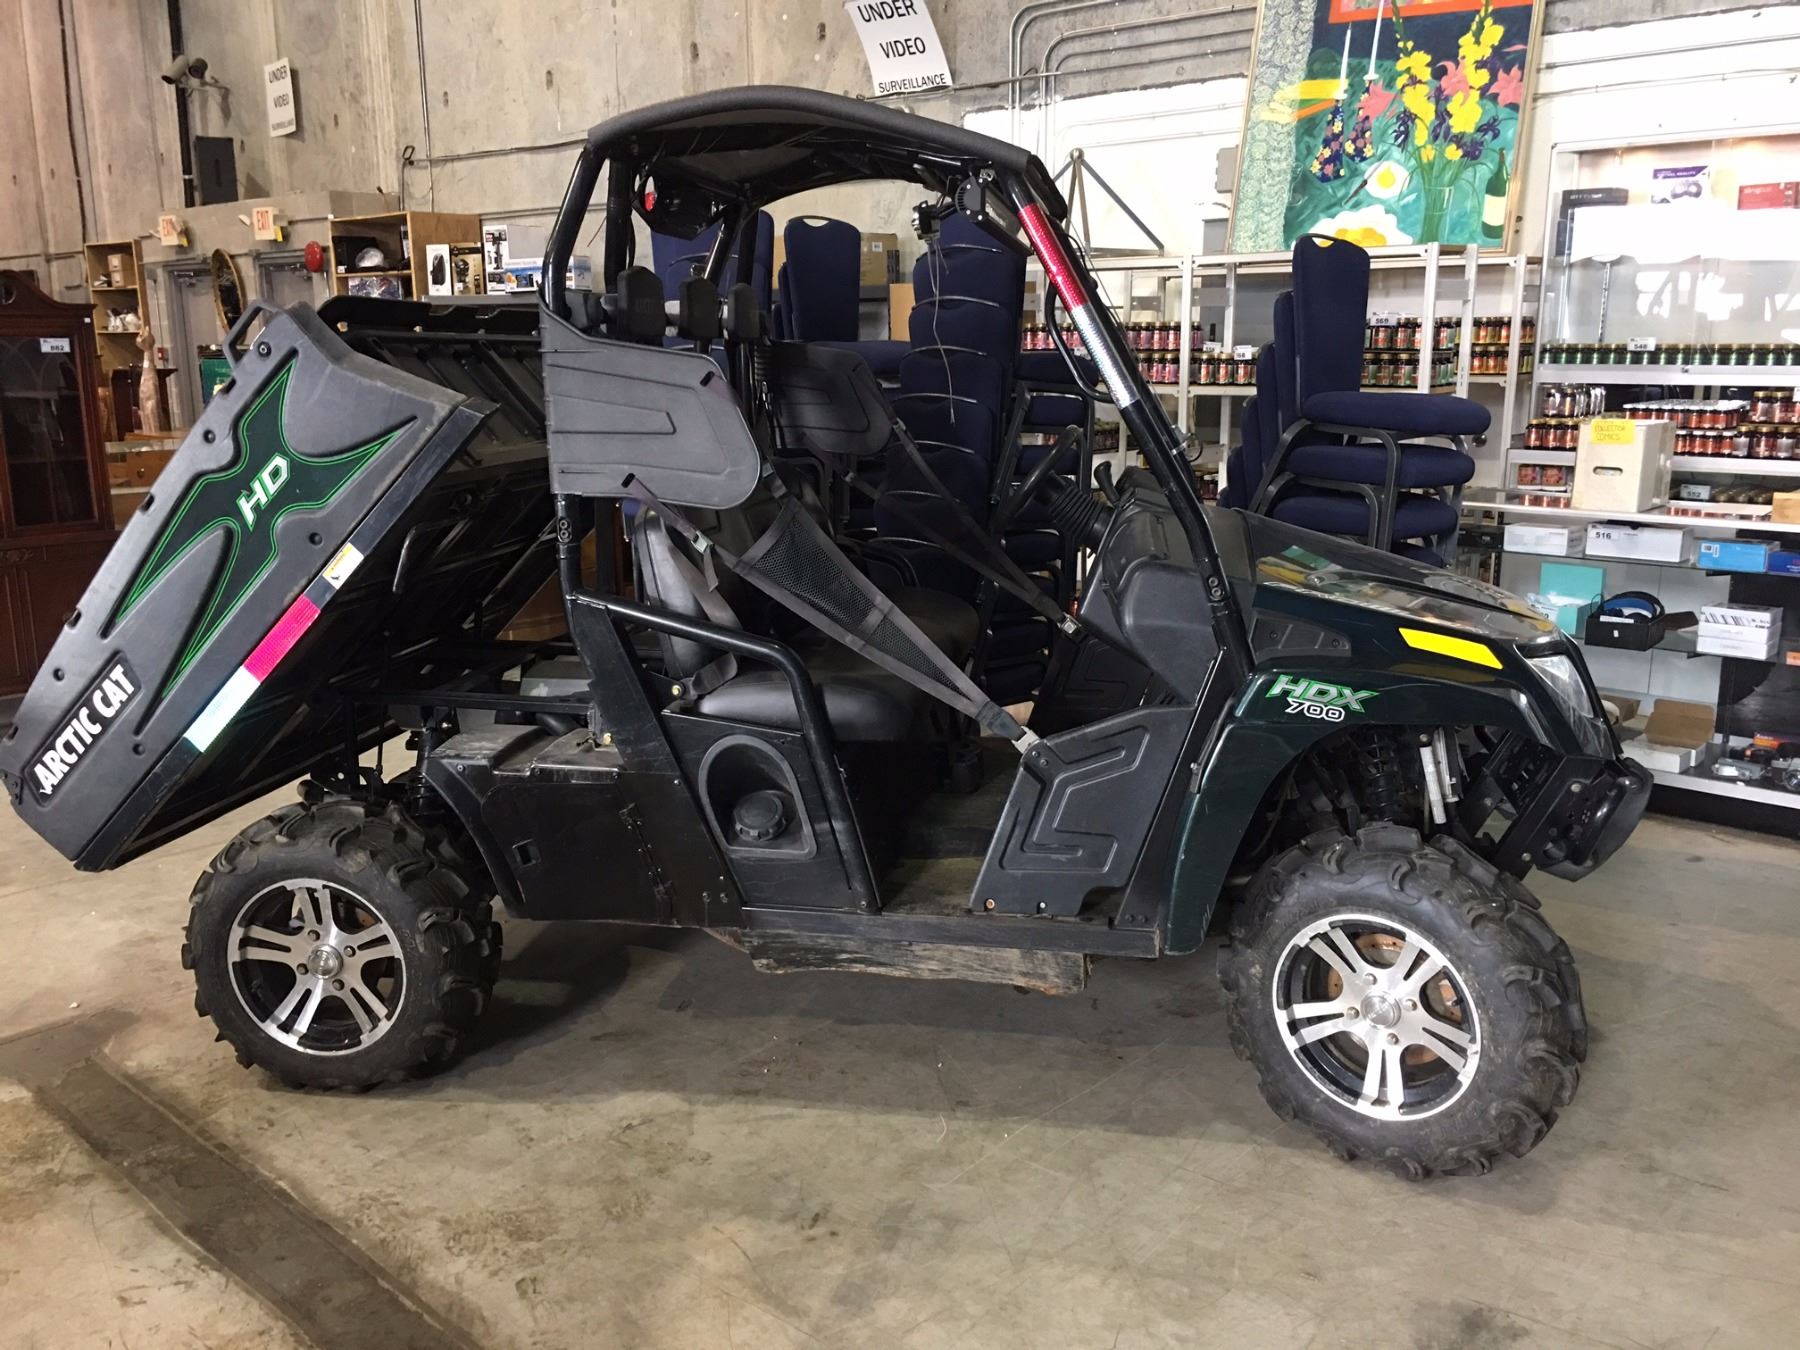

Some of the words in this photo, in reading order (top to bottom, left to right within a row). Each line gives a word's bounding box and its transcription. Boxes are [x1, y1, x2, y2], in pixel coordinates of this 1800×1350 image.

[857, 0, 918, 23] UNDER
[879, 37, 926, 59] VIDEO
[268, 65, 288, 83] UNDER
[878, 73, 947, 94] SURVEILLANCE
[273, 93, 290, 109] VIDEO
[236, 452, 290, 532] HD
[1595, 531, 1612, 540] 516
[1265, 674, 1380, 713] HDX
[1285, 697, 1346, 722] 700
[33, 706, 103, 795] ARCTIC
[92, 663, 135, 718] CAT
